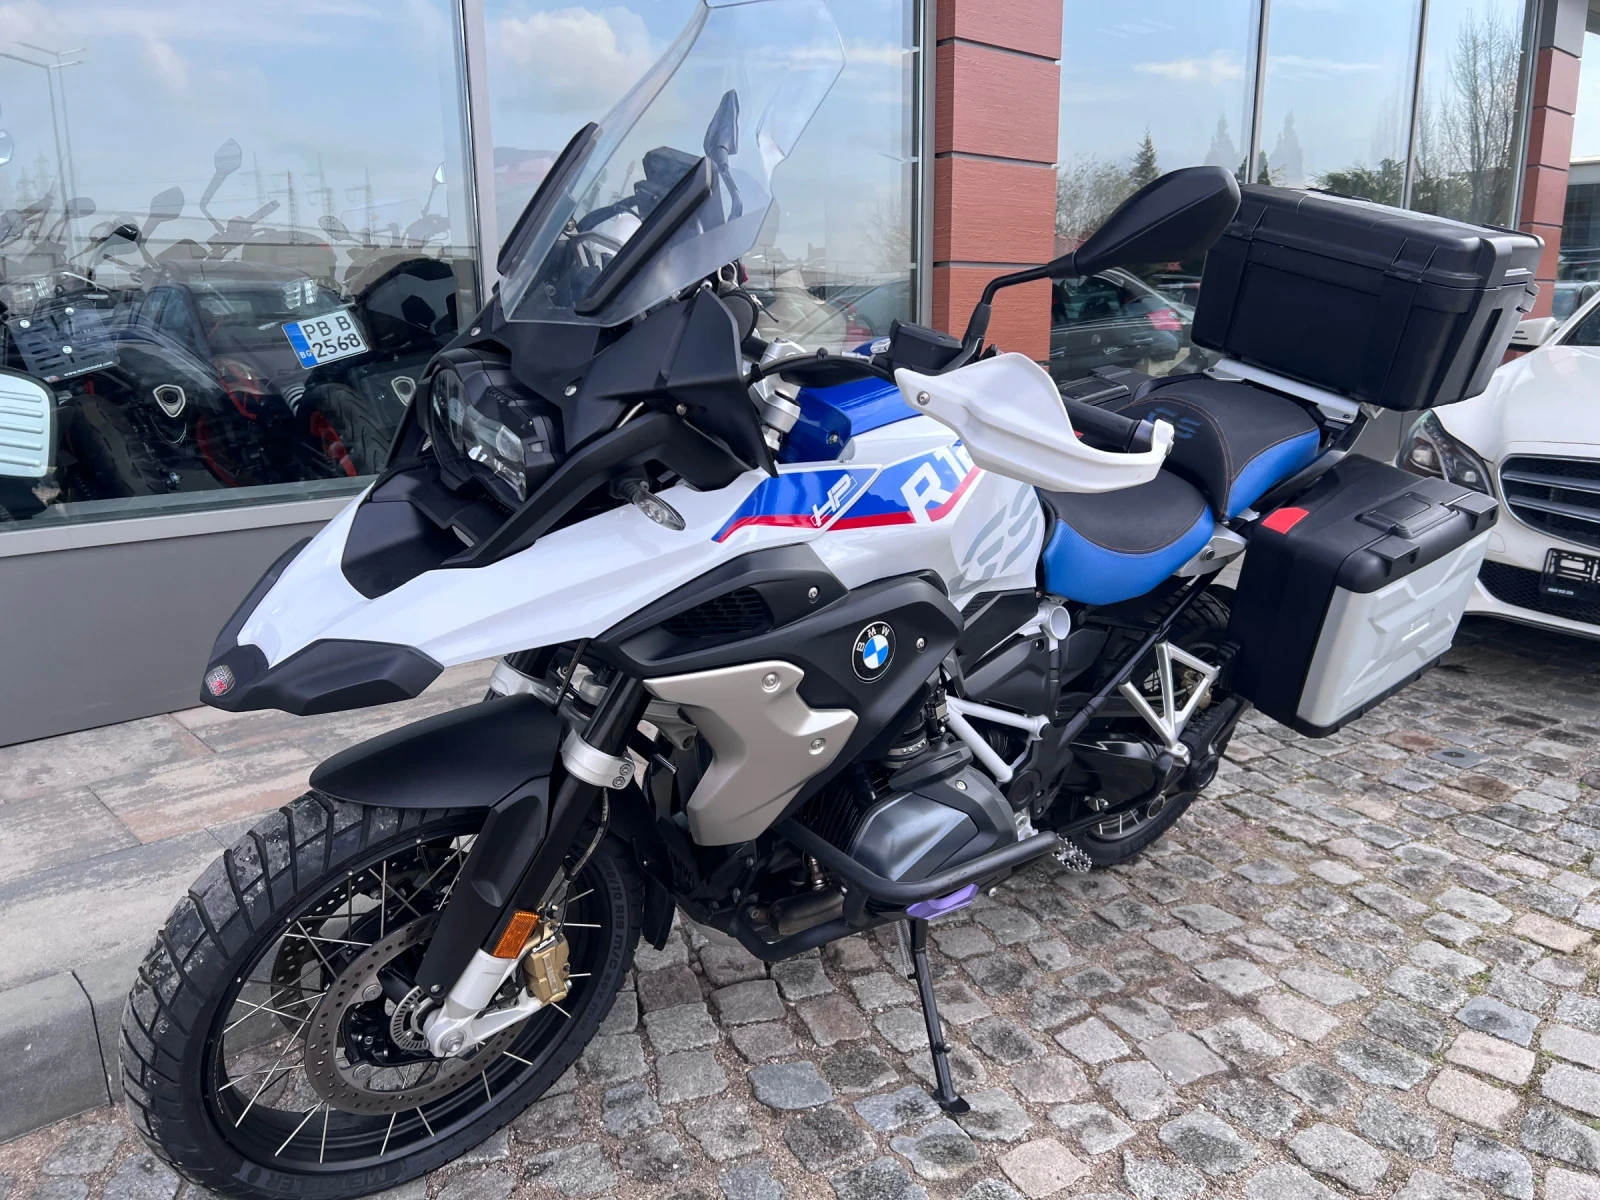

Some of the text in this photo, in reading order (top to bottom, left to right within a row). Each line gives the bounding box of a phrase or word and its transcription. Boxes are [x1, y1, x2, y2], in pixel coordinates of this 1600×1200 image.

[302, 315, 351, 340] PB B
[299, 349, 312, 359] BG
[312, 333, 360, 358] 2568
[810, 473, 857, 527] HP
[856, 625, 890, 652] BMW
[614, 904, 625, 929] R19
